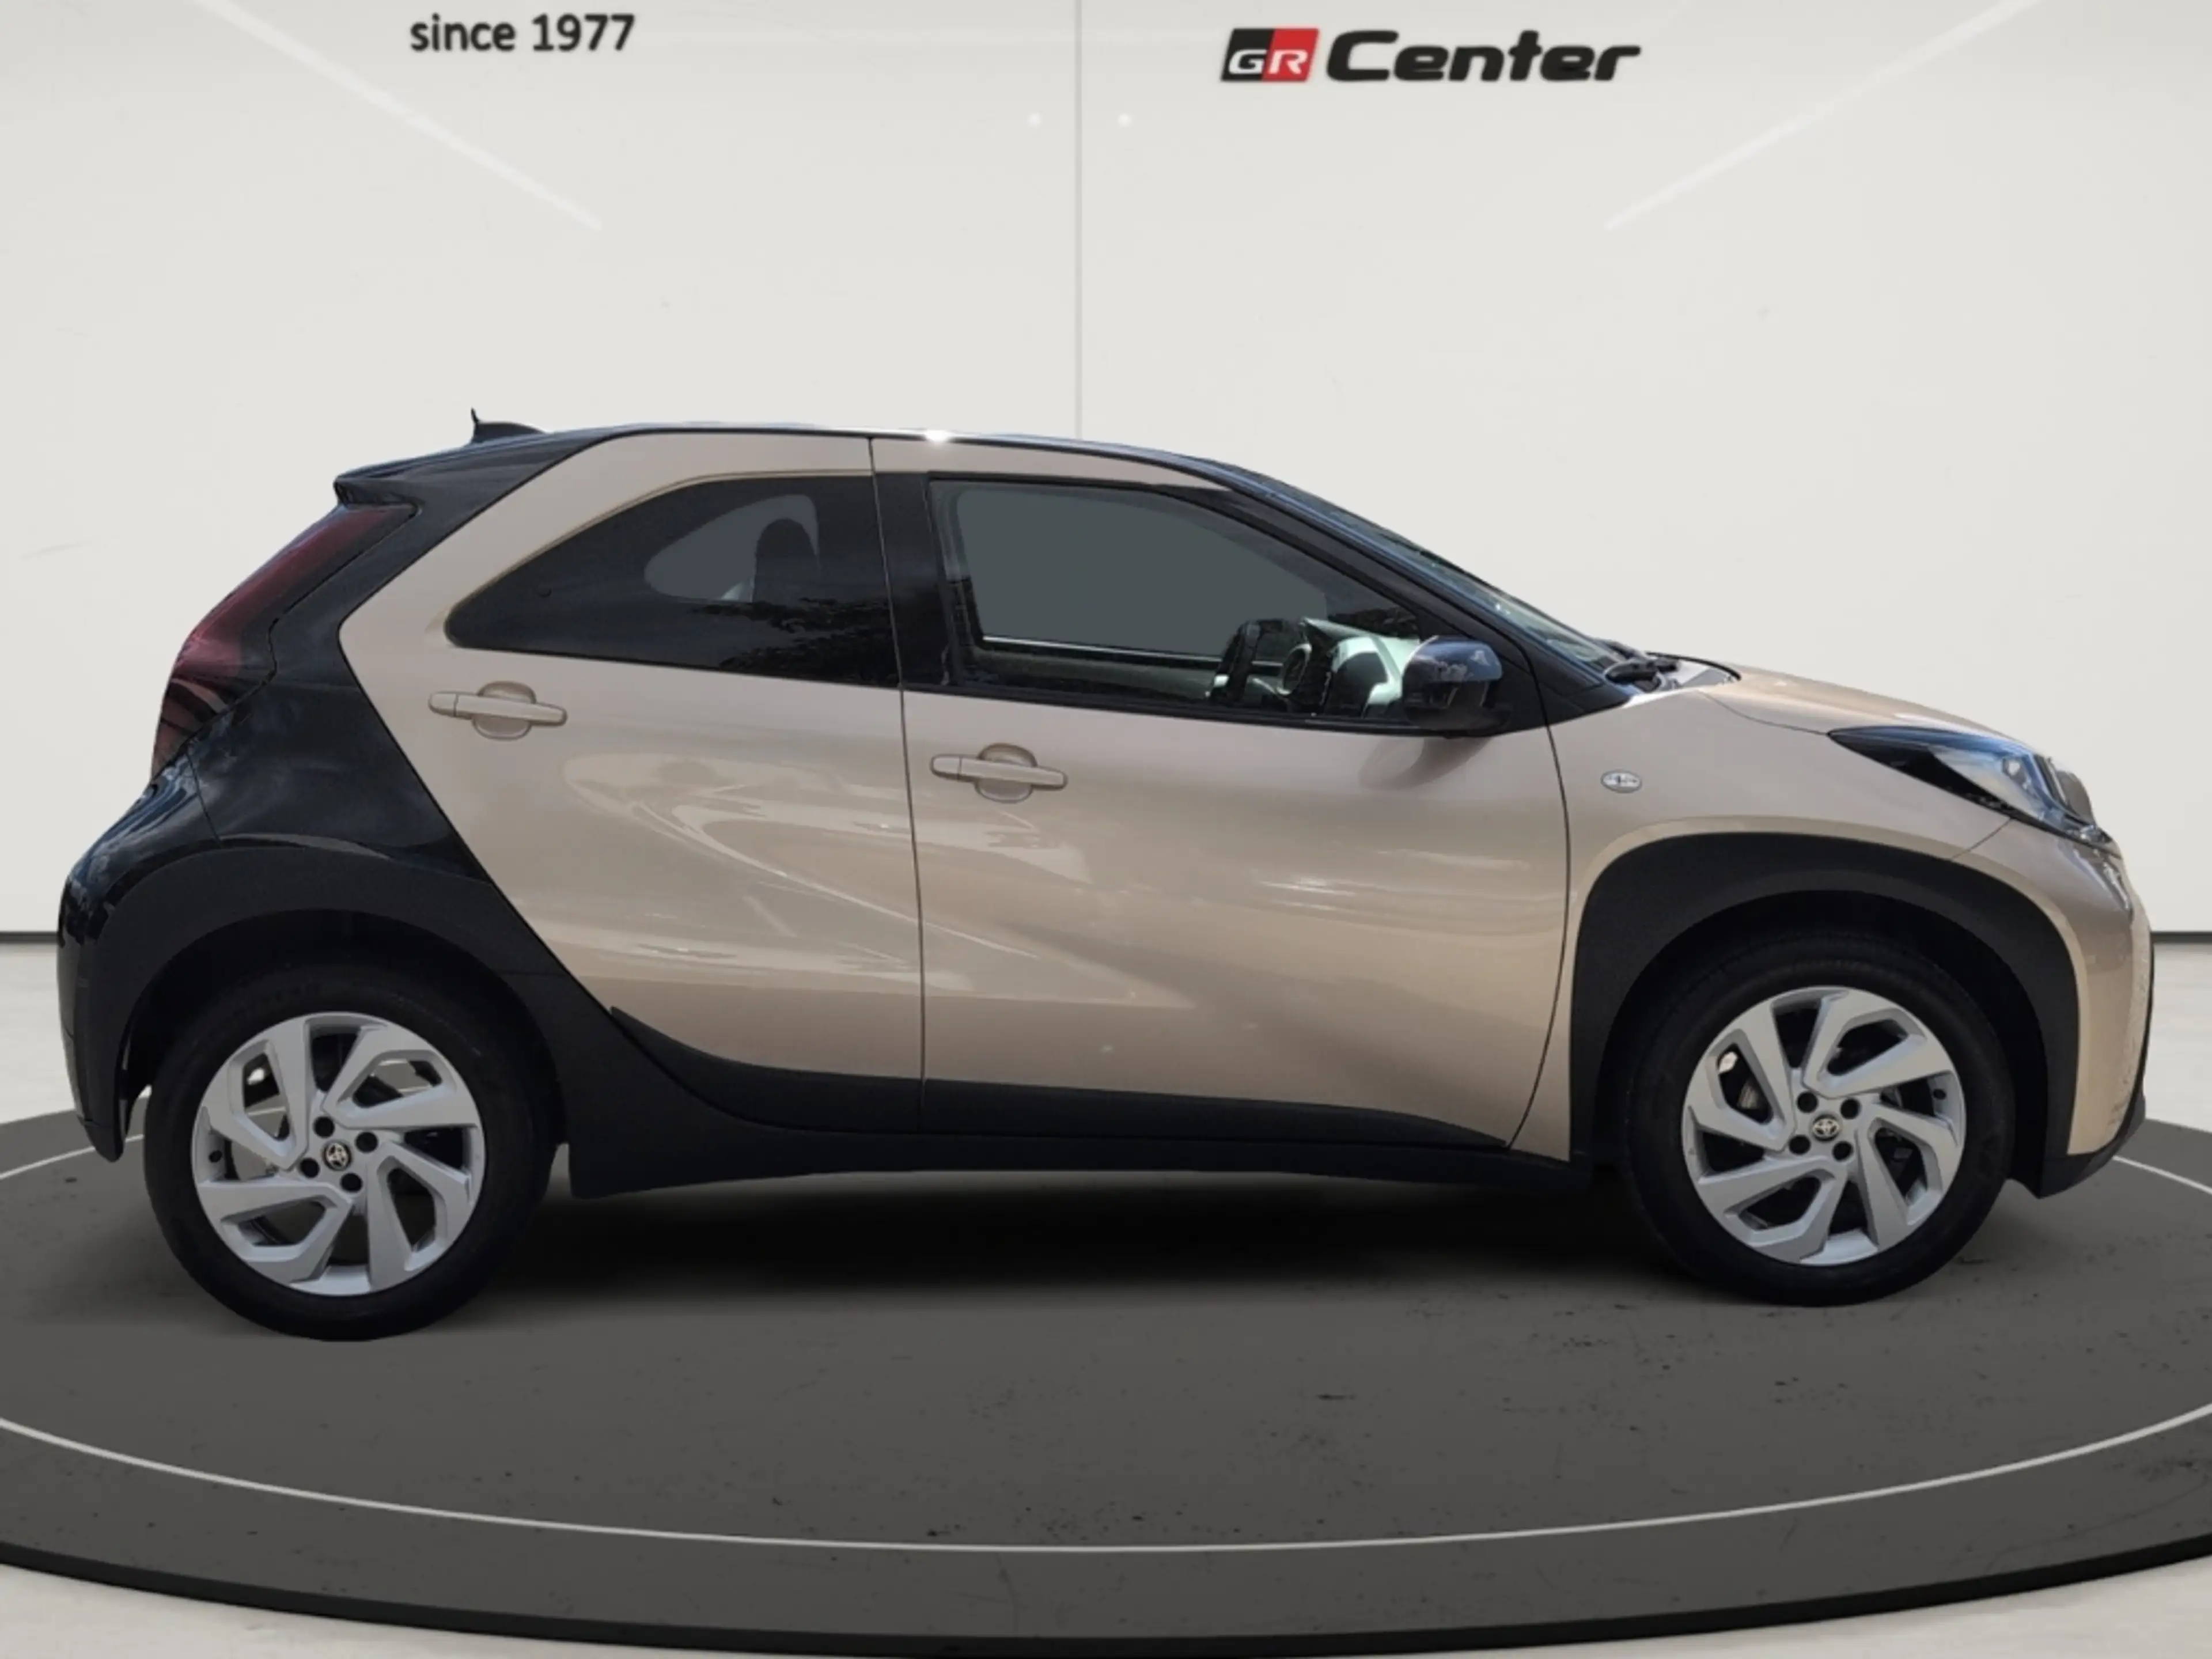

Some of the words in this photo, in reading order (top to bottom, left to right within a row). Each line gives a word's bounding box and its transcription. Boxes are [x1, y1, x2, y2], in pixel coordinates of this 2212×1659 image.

[410, 13, 516, 52] since
[532, 13, 635, 52] 1977
[1228, 48, 1310, 75] GR
[1326, 30, 1641, 82] Center
